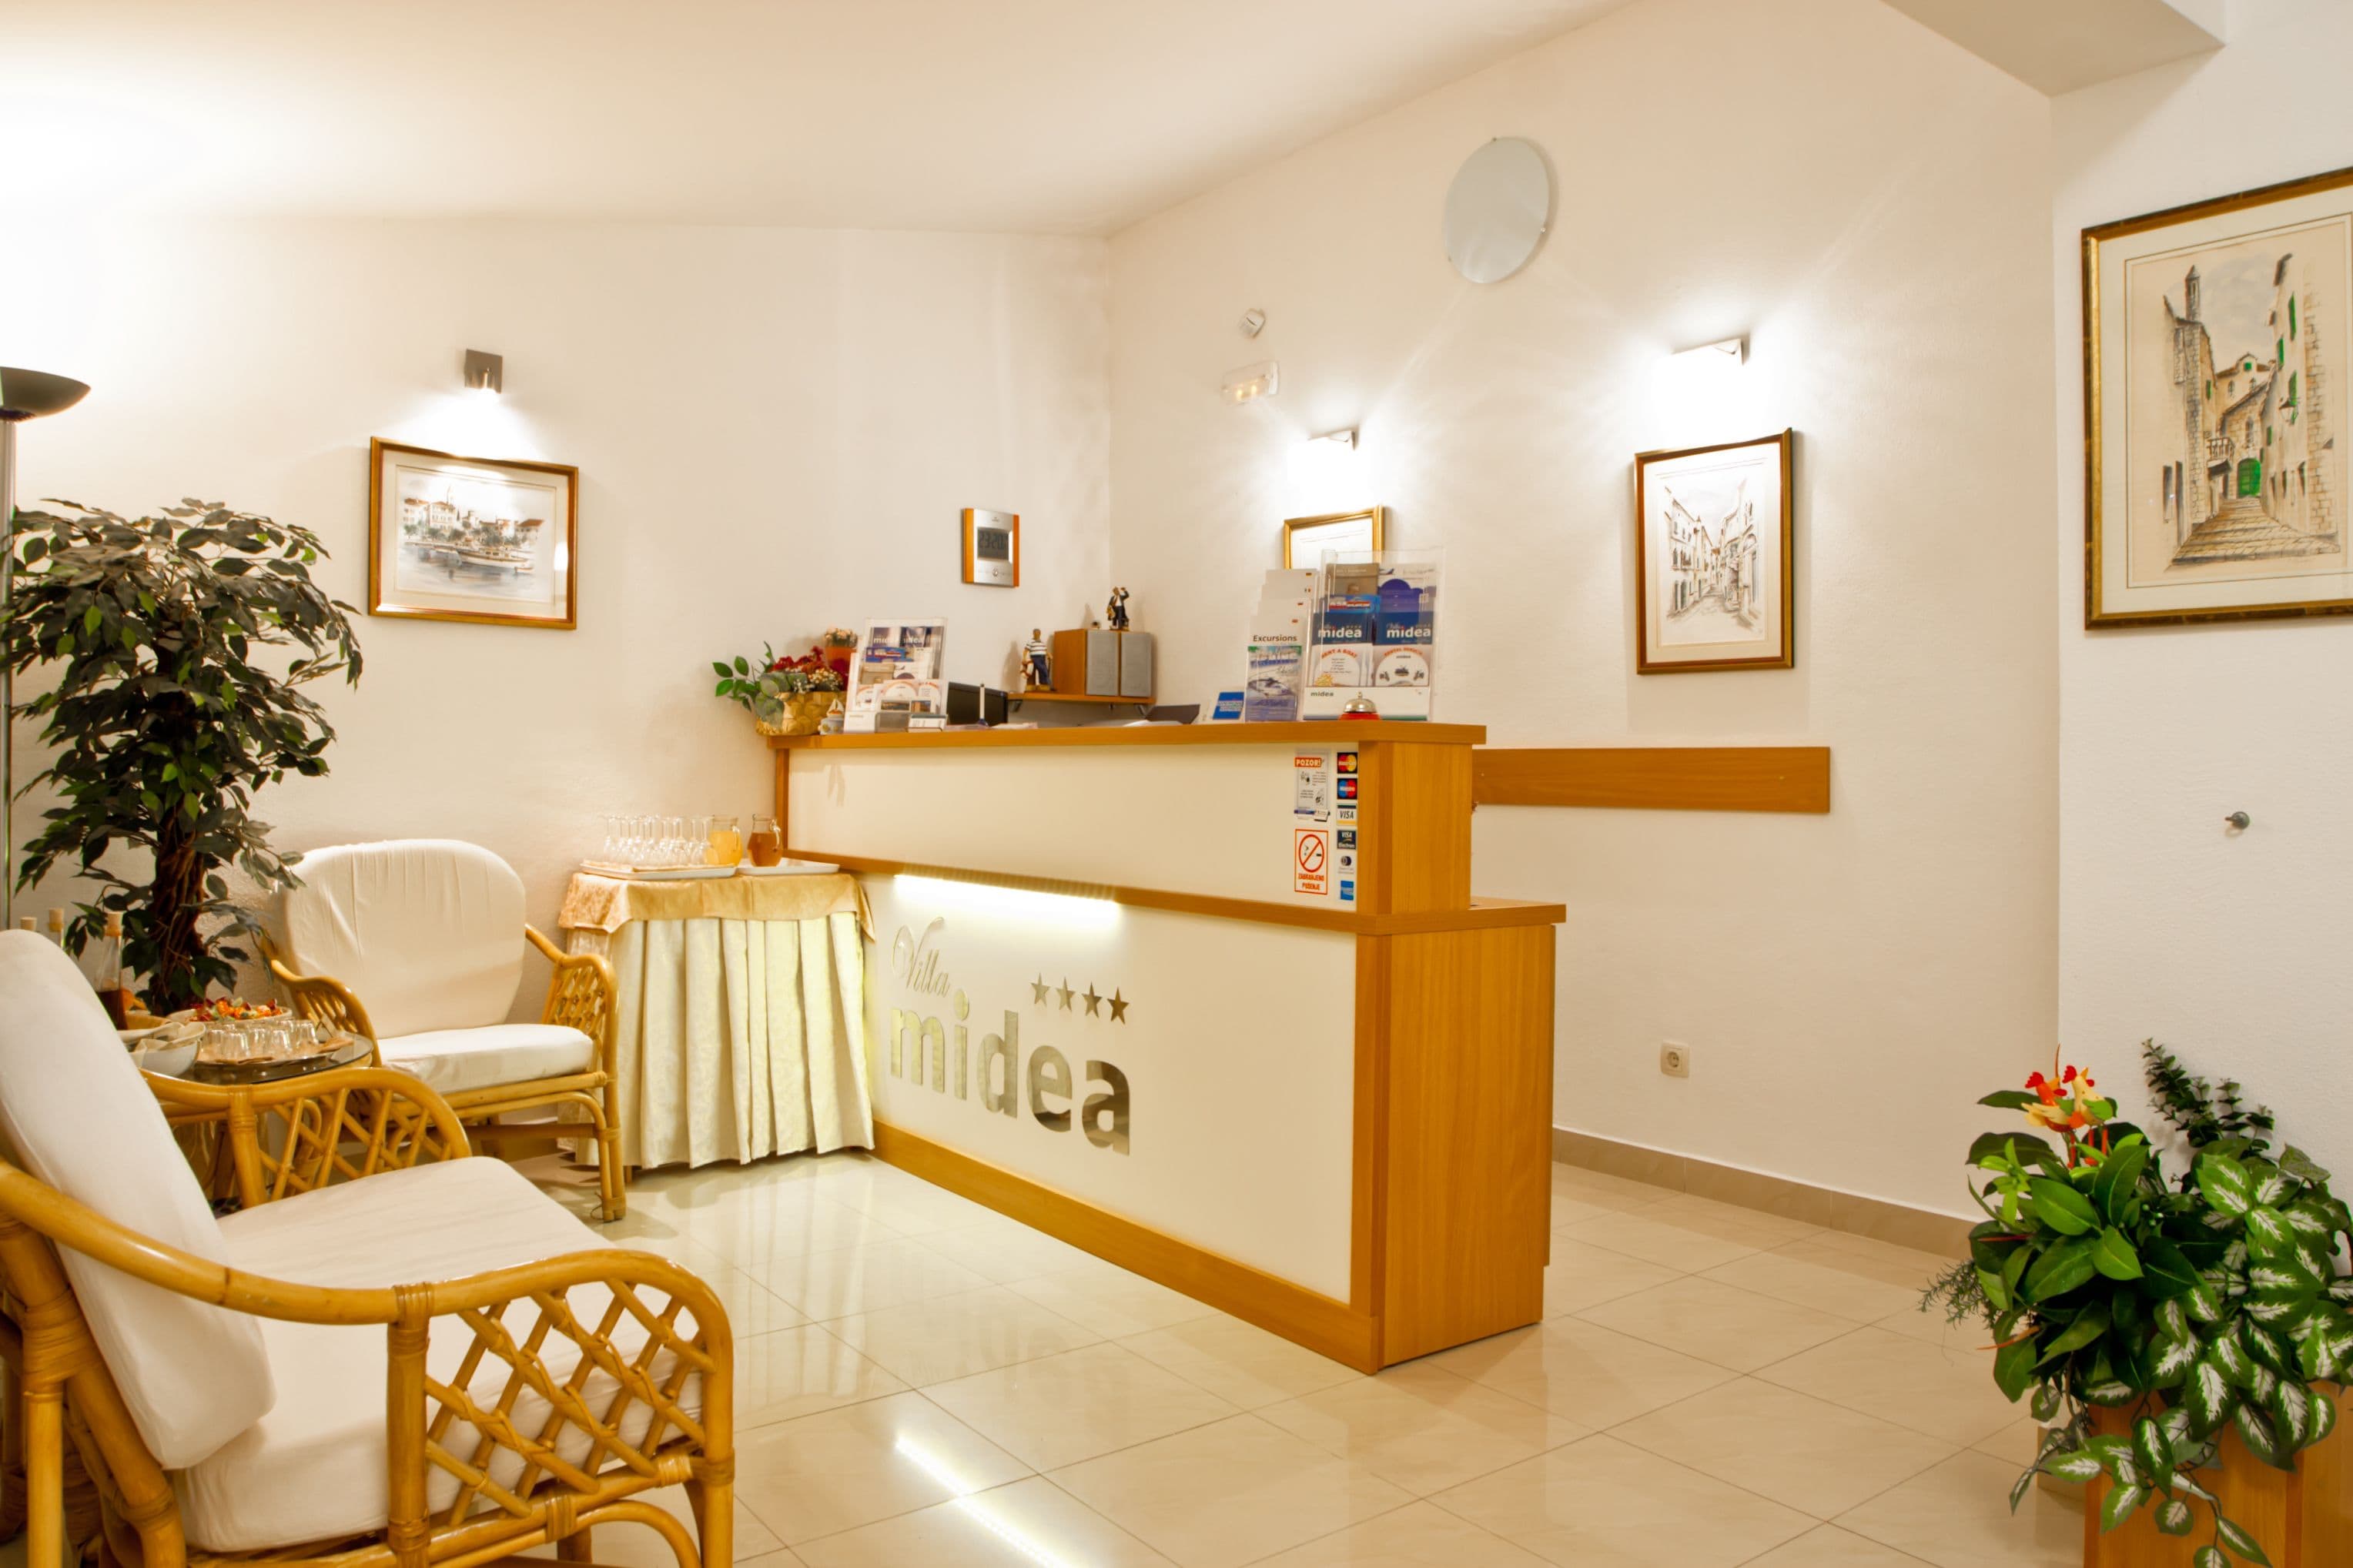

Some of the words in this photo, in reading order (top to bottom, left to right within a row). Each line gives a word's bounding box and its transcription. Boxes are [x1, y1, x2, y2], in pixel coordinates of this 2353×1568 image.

[1318, 624, 1362, 638] midea
[1387, 624, 1431, 638] midea
[1296, 758, 1321, 767] POZOR!
[1340, 811, 1354, 820] VISA
[892, 917, 951, 998] Villa
[891, 988, 1130, 1156] midea
